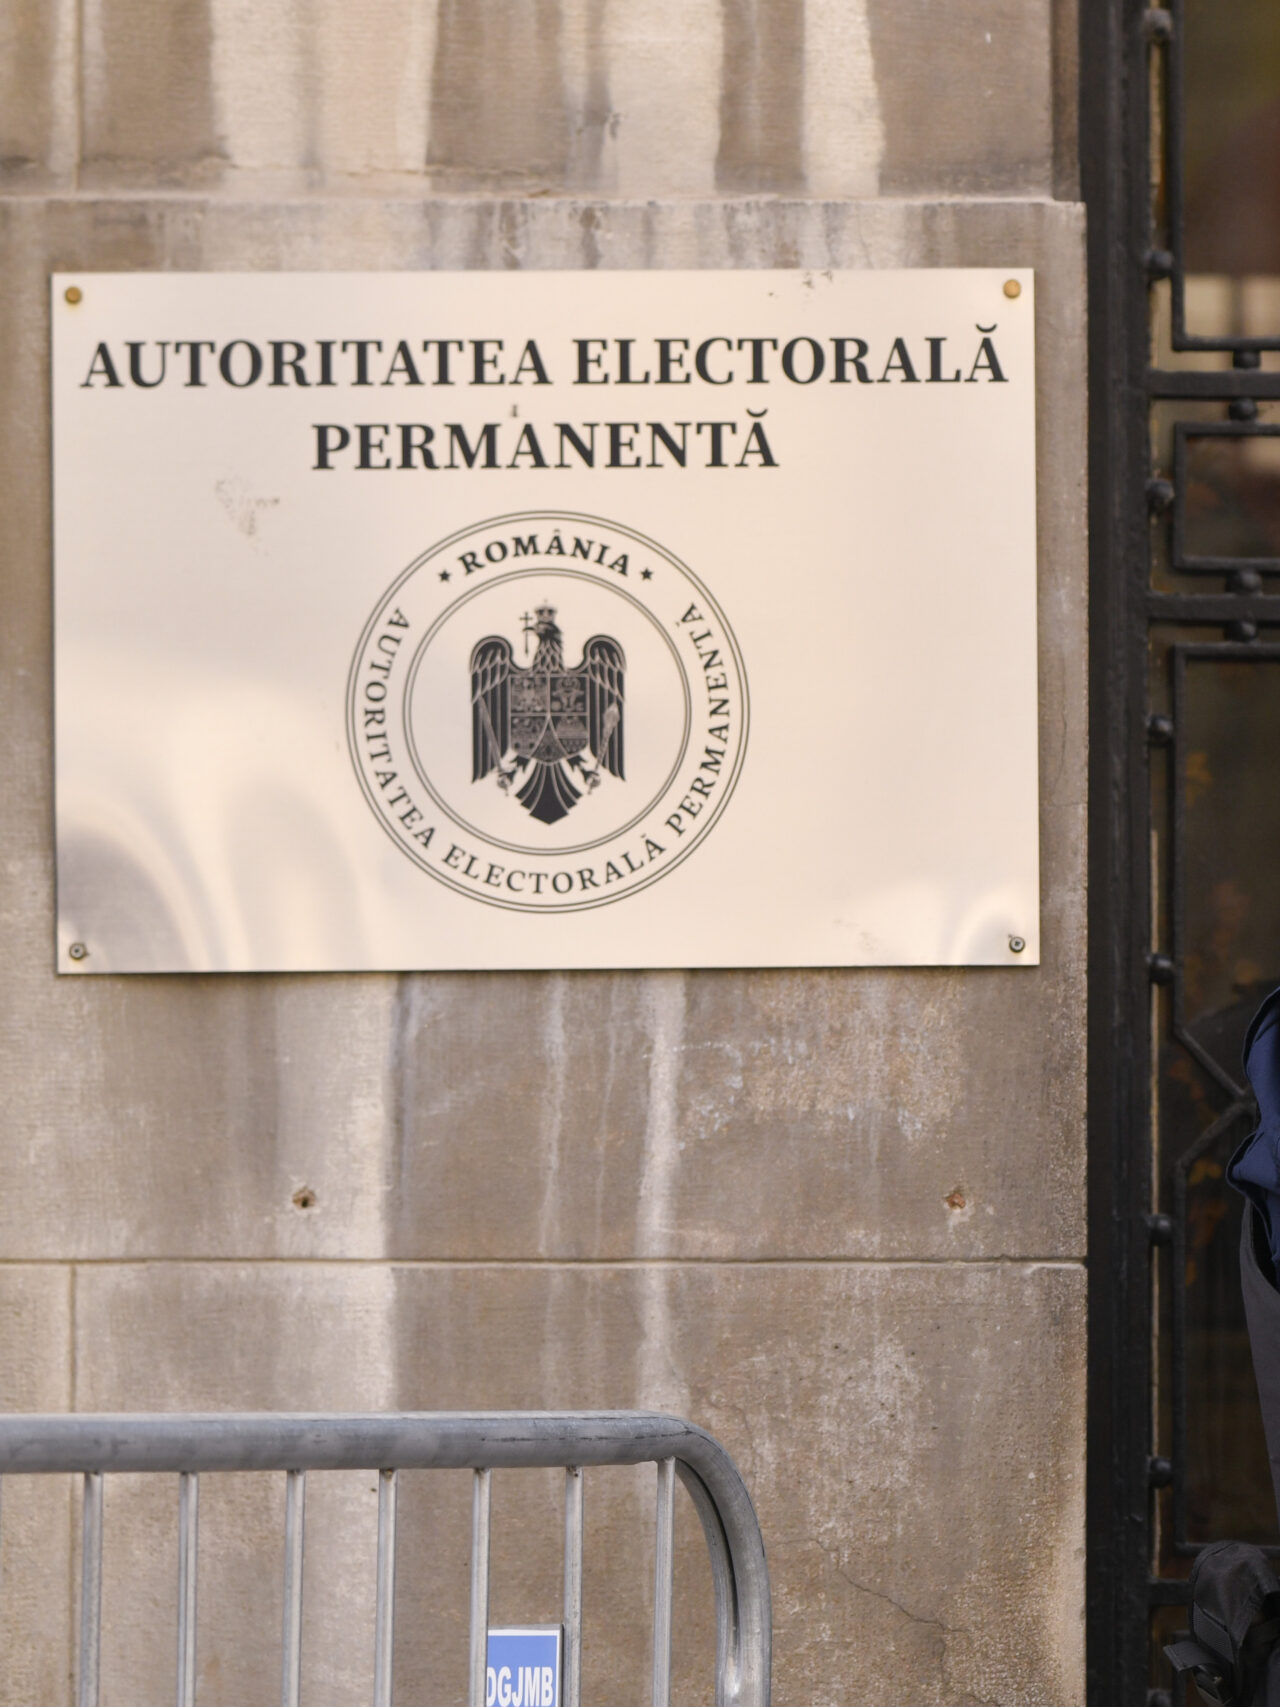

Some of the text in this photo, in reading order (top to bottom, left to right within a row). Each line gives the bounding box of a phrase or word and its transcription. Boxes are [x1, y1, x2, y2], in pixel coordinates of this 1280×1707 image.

[80, 324, 1008, 388] AUTORITATEA ELECTORALĂ
[312, 408, 779, 471] PERMANENTĂ
[458, 529, 630, 576] ROMÂNIA
[365, 602, 731, 894] AUTORITATEA ELECTORALĂ PERMANENTĂ
[486, 1666, 553, 1707] DGJMB
